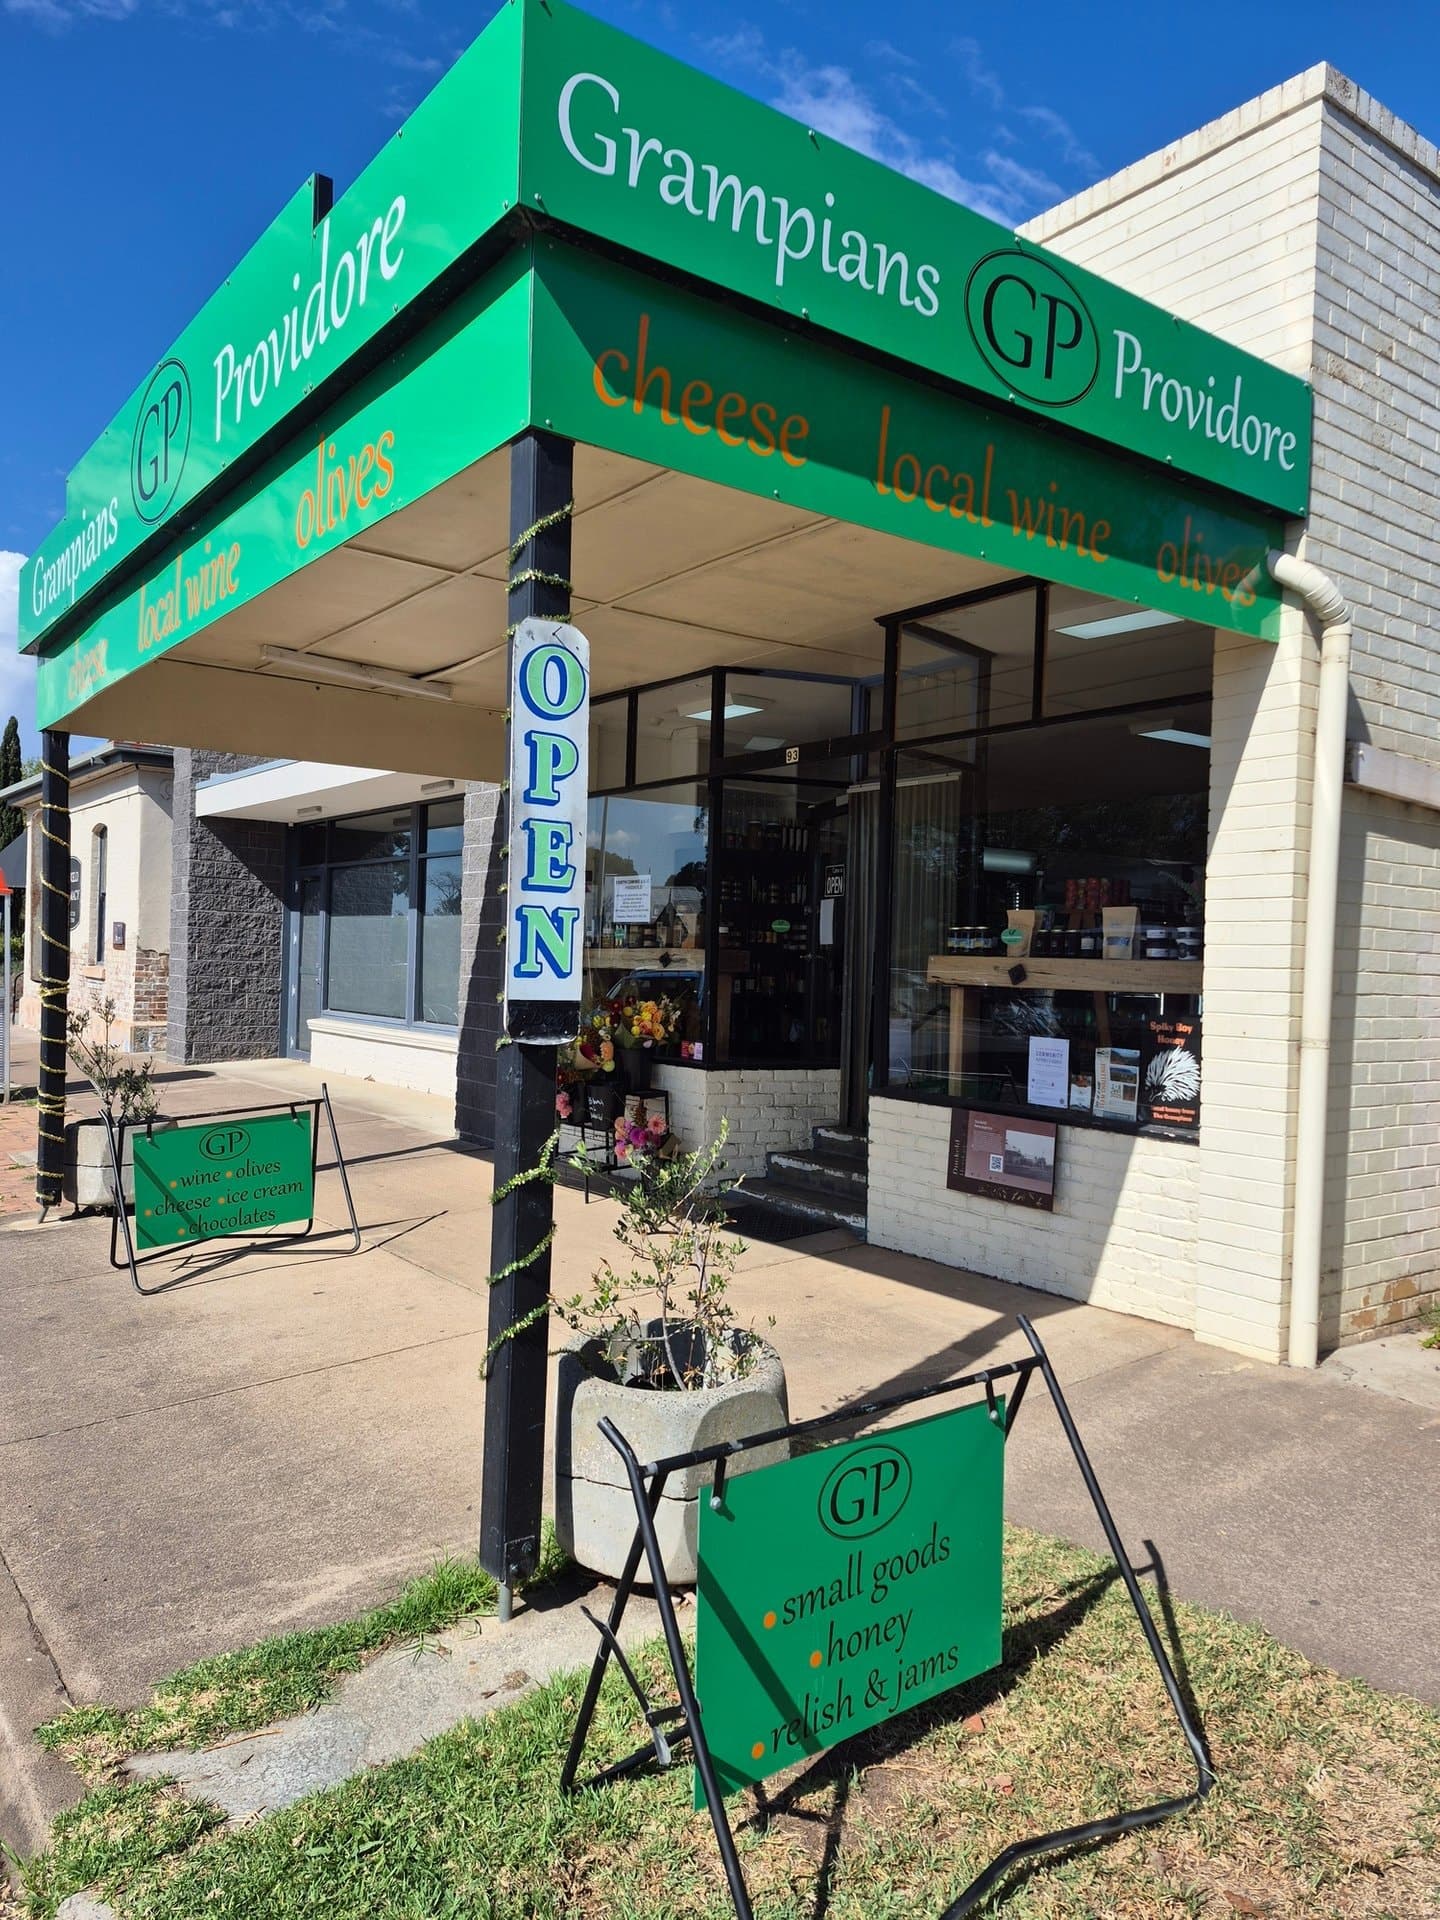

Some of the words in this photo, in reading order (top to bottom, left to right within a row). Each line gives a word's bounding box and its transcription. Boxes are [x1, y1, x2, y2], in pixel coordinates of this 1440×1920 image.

[558, 72, 941, 317] Grampians
[982, 273, 1084, 379] GP
[1113, 329, 1297, 471] Providore
[32, 497, 119, 617] Grampians
[137, 380, 183, 502] GP
[213, 194, 406, 442] Providore
[592, 313, 810, 467] cheese
[874, 405, 994, 527] local
[1007, 482, 1112, 562] wine
[1156, 515, 1257, 606] olives
[137, 551, 183, 652] local
[186, 537, 241, 620] wine
[295, 430, 396, 549] olives
[787, 749, 798, 762] 93
[513, 643, 587, 979] OPEN
[826, 875, 843, 894] OPEN
[1150, 1020, 1173, 1033] Spiky
[1175, 1021, 1193, 1035] Boy
[1157, 1034, 1186, 1047] Honey
[180, 1169, 221, 1188] wine
[235, 1158, 281, 1179] olives
[206, 1130, 244, 1157] GP
[154, 1194, 212, 1217] cheese
[225, 1188, 249, 1205] ice
[253, 1181, 304, 1200] cream
[188, 1207, 276, 1236] chocolates
[829, 1457, 901, 1526] GP
[782, 1549, 864, 1627] small
[872, 1520, 951, 1604] goods
[826, 1608, 914, 1668] honey
[771, 1679, 855, 1755] relish
[864, 1669, 889, 1709] &
[888, 1645, 960, 1713] jams
